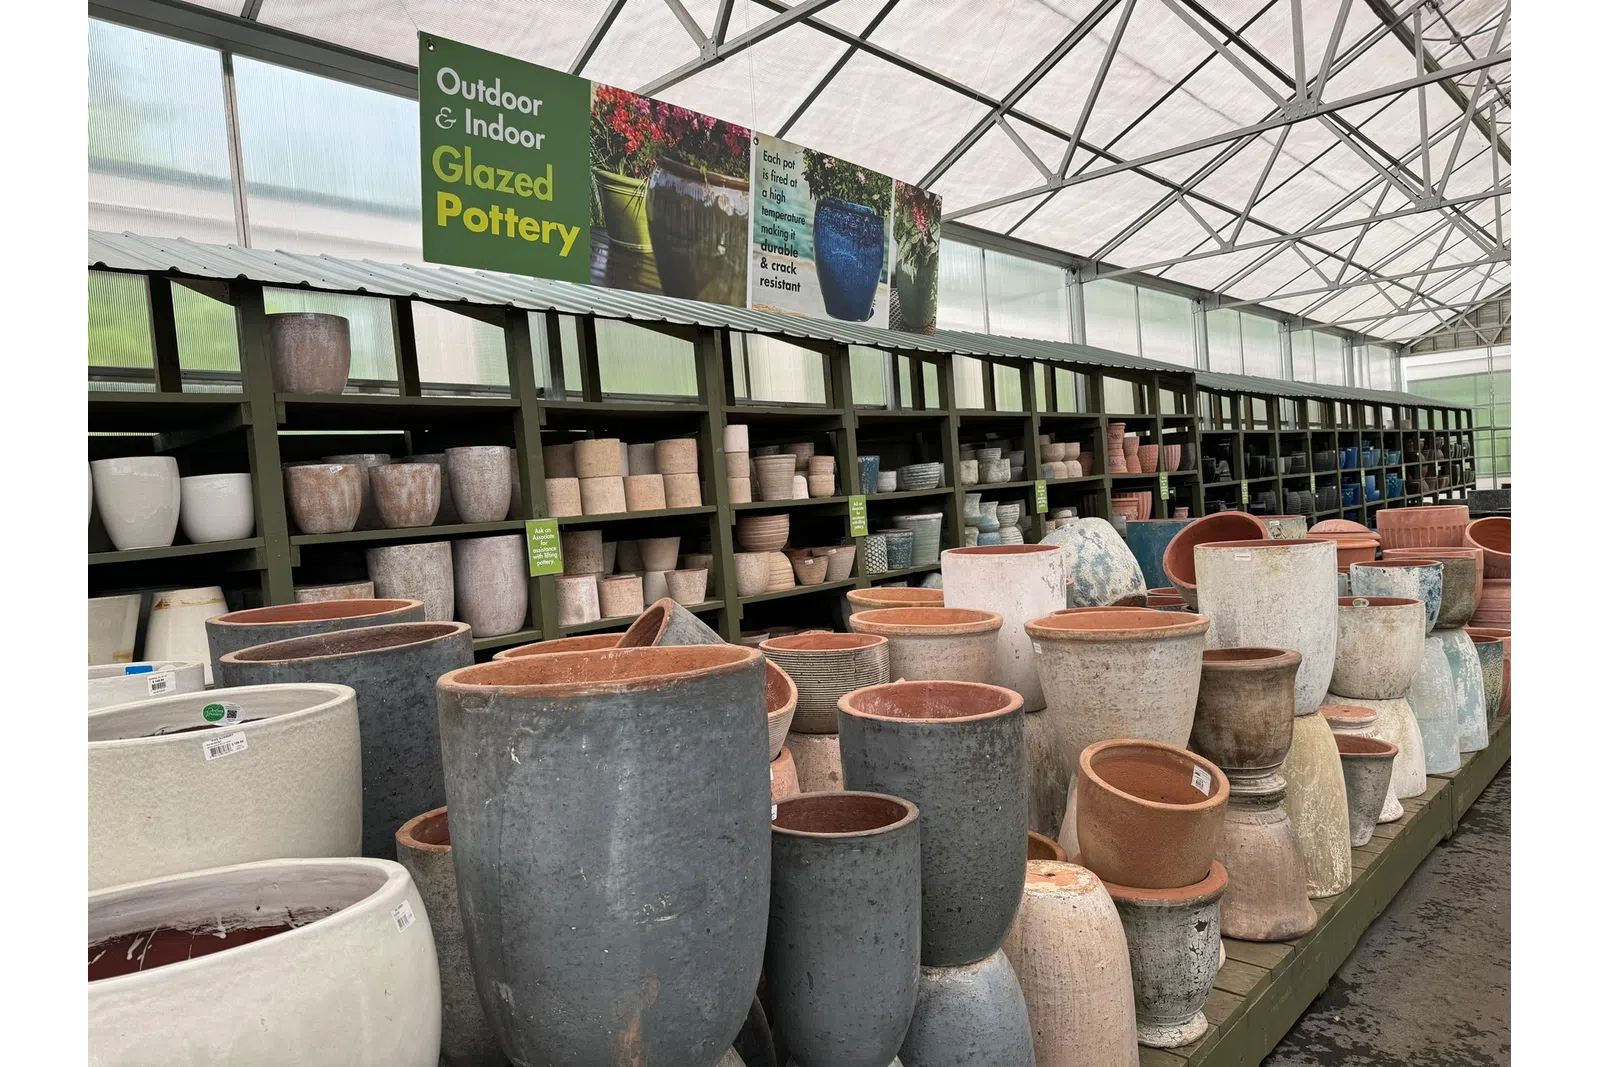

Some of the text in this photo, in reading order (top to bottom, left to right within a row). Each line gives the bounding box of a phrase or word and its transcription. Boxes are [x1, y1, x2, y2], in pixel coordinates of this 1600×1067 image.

[436, 66, 543, 116] Outdoor
[435, 106, 545, 150] & Indoor
[763, 149, 796, 171] Each pot
[432, 145, 553, 202] Glazed
[762, 168, 798, 189] is fired at
[761, 187, 786, 205] a high
[436, 191, 580, 257] Pottery
[761, 205, 806, 226] temperature
[760, 225, 796, 242] making it
[760, 239, 799, 258] durable
[760, 256, 798, 276] & crack
[759, 276, 801, 293] resistant
